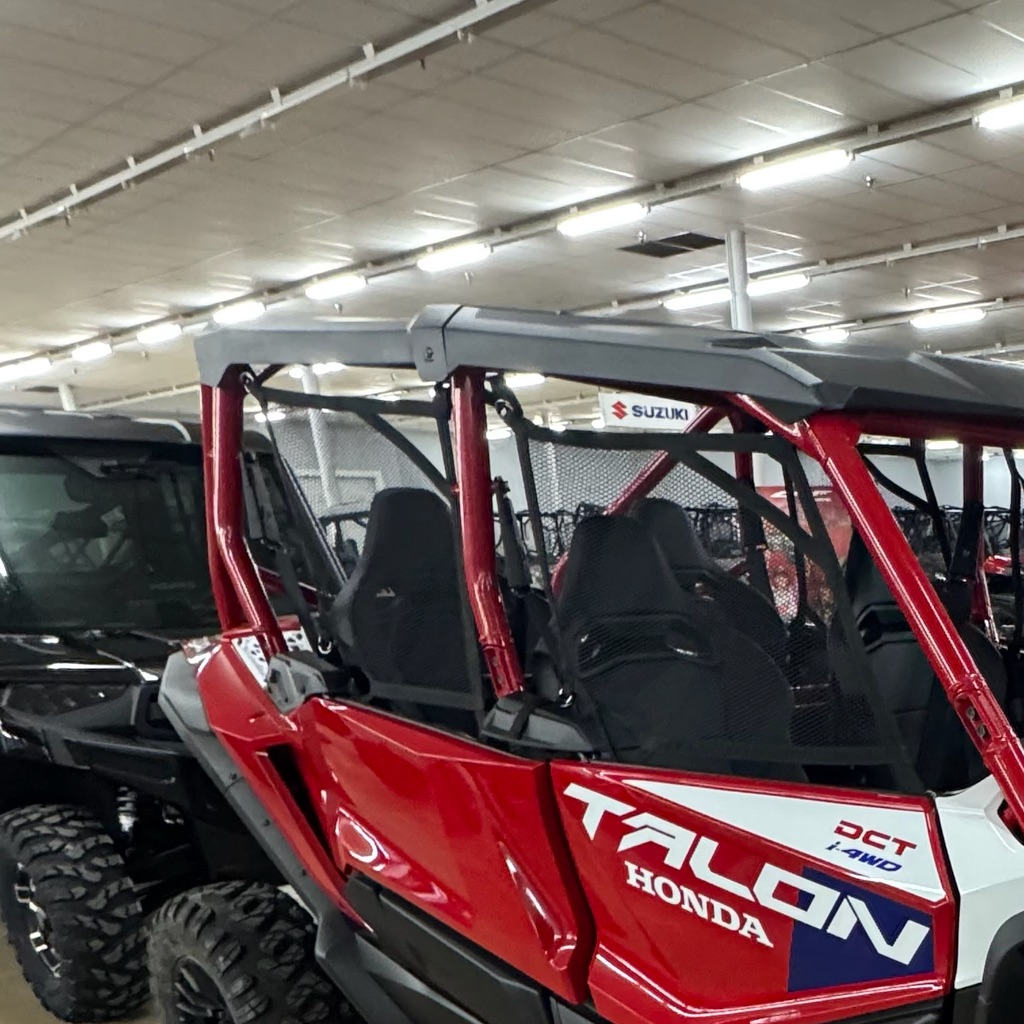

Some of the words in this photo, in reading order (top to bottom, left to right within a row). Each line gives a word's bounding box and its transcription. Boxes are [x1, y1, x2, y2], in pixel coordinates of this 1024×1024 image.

[631, 404, 689, 421] SUZUKI
[825, 840, 903, 873] i-4WD
[833, 819, 918, 857] DCT
[562, 781, 931, 966] TALON
[623, 860, 775, 949] HONDA
